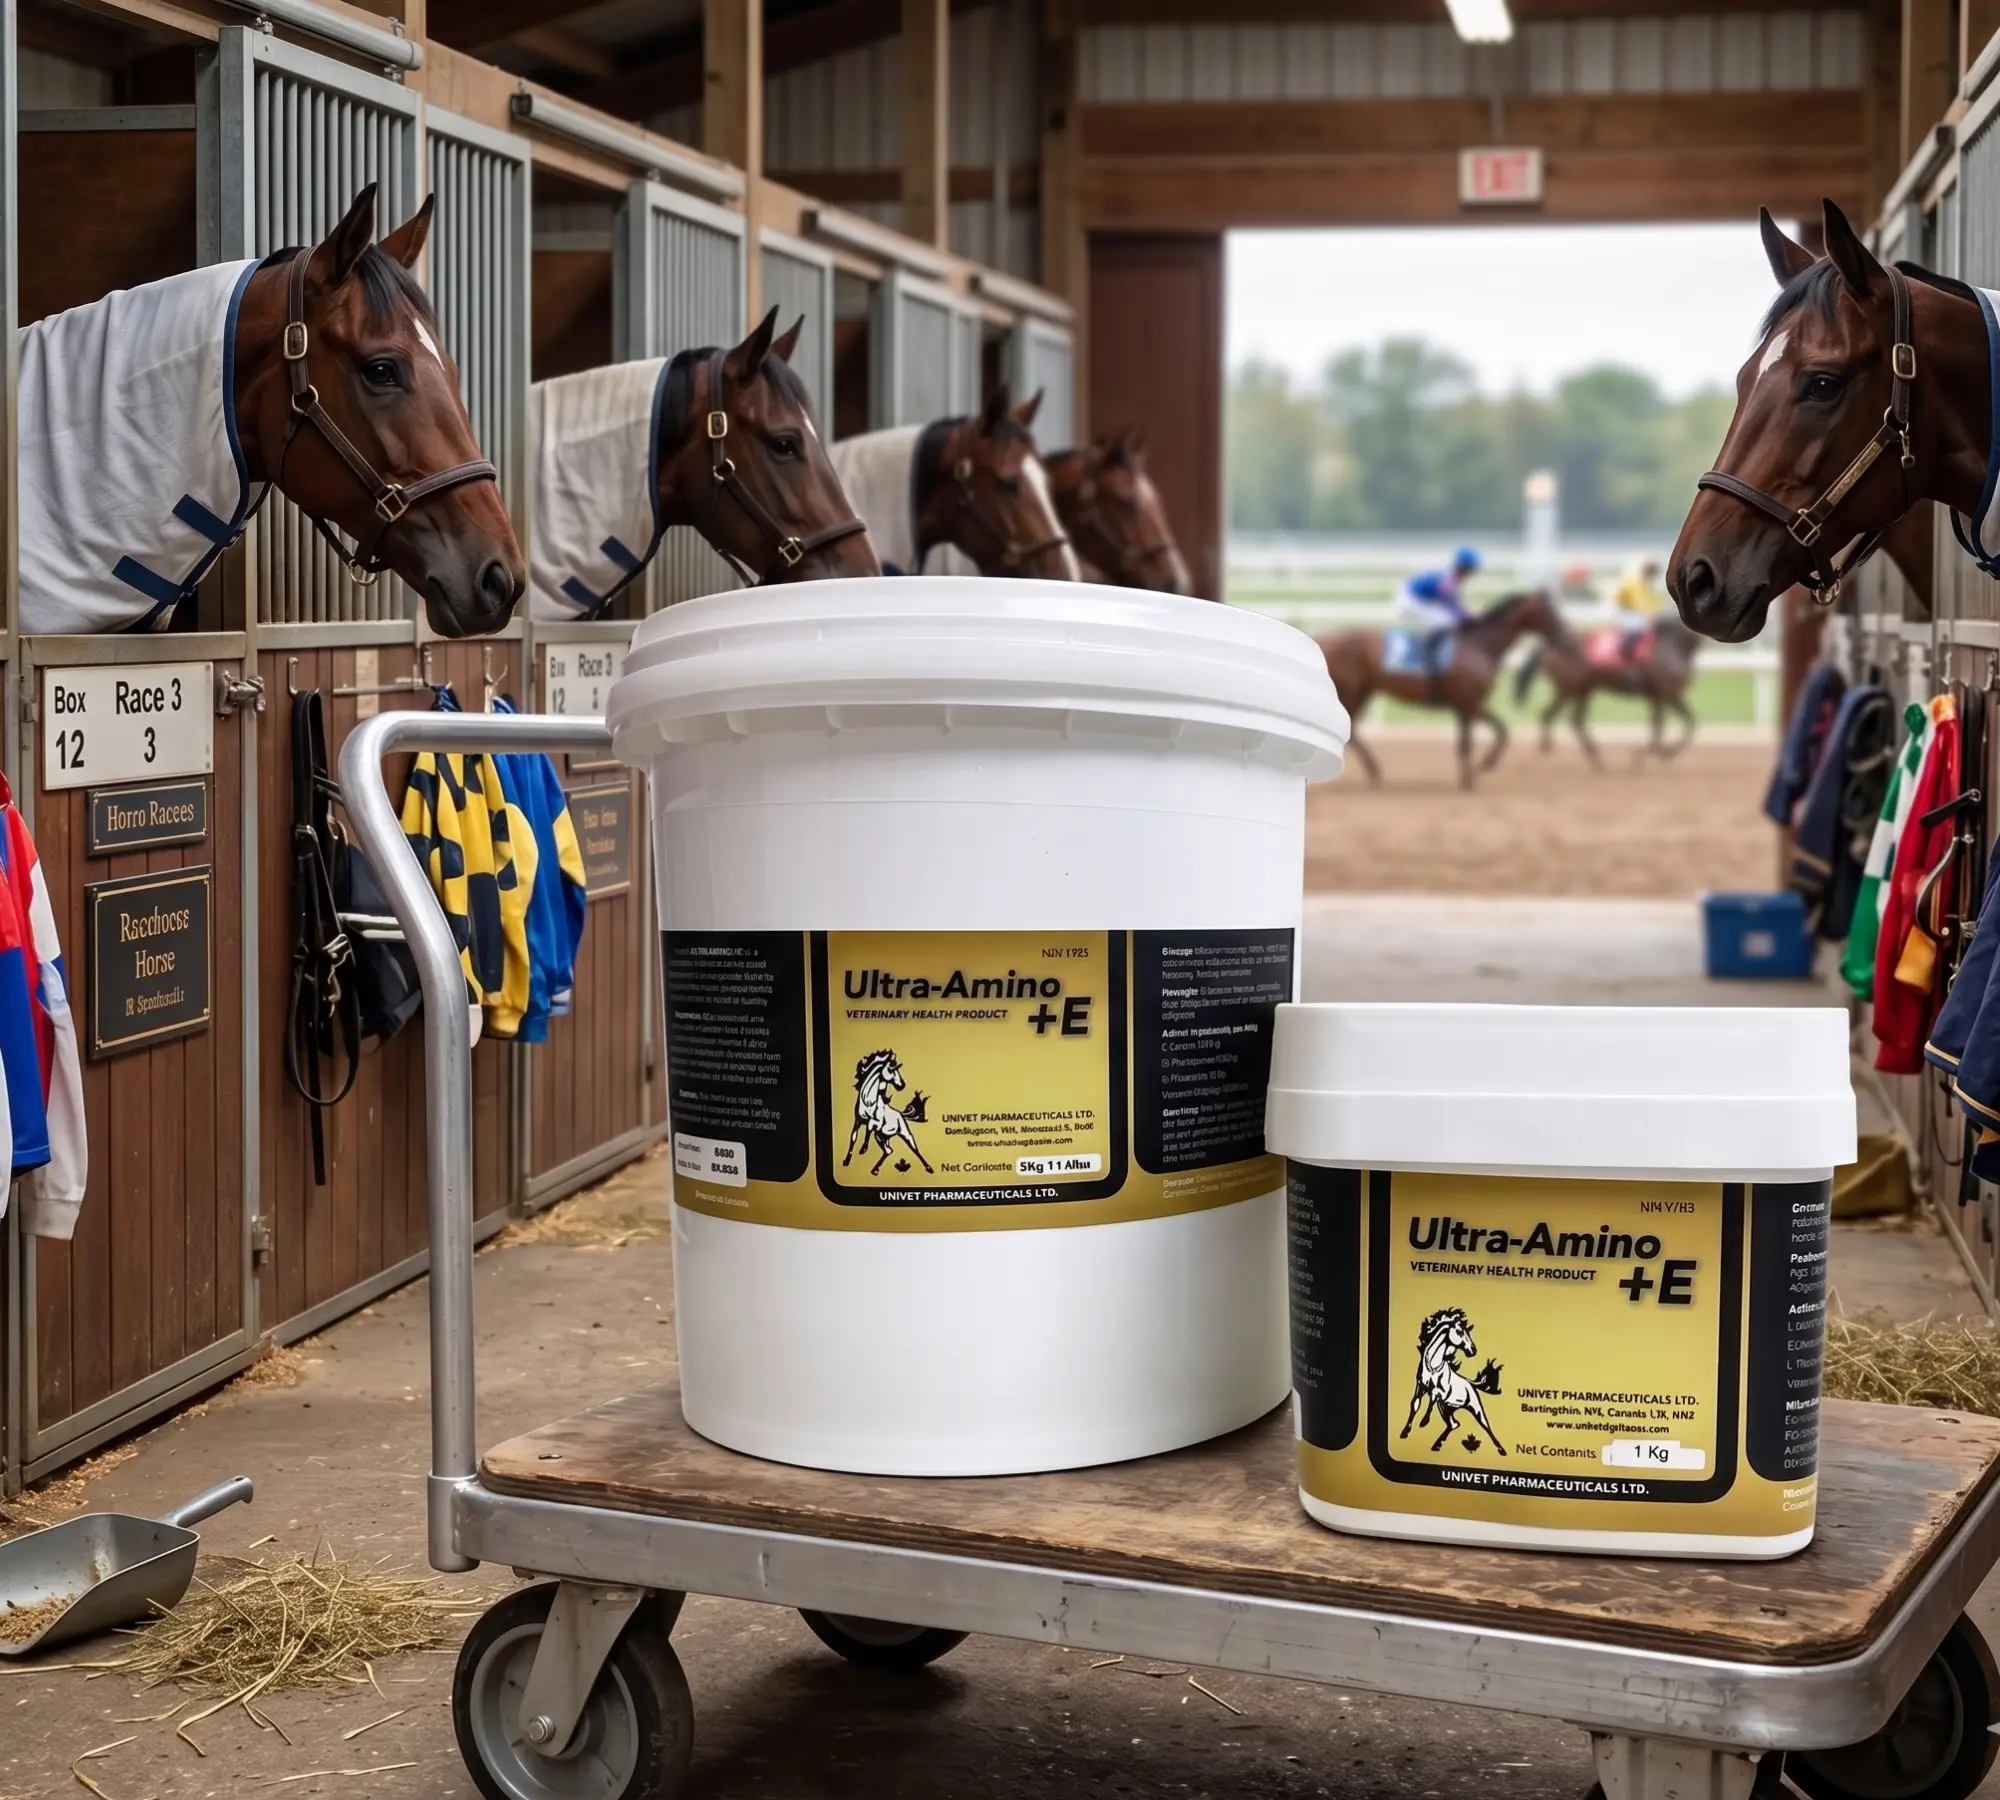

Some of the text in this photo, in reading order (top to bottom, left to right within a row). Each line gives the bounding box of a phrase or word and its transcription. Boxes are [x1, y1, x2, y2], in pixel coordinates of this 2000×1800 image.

[54, 678, 182, 715] Box Race 3
[56, 727, 156, 769] 12 3
[135, 950, 175, 978] Horse
[844, 969, 1061, 1000] Ultra-Amino
[846, 1009, 1008, 1020] VETERINARY HEALTH PRODUCT
[1028, 997, 1092, 1035] +E
[942, 1110, 1096, 1123] UNIVET PHARMACEUTICALS LTD.
[941, 1163, 960, 1173] Net
[1020, 1161, 1044, 1174] 5Kg
[879, 1188, 1059, 1201] UNIVET PHARMACEUTICALS LTD.
[1409, 1216, 1662, 1260] Ultra-Amino
[1410, 1261, 1597, 1281] VETERINARY HEALTH PRODUCT
[1619, 1260, 1697, 1305] +E
[1518, 1388, 1700, 1405] UNIVET PHARMACEUTICALS LTD.
[1516, 1443, 1537, 1455] Net
[1634, 1446, 1641, 1458] 1
[1648, 1445, 1669, 1462] Kg
[1442, 1470, 1650, 1495] UNIVET PHARMACEUTICALS LTD.
